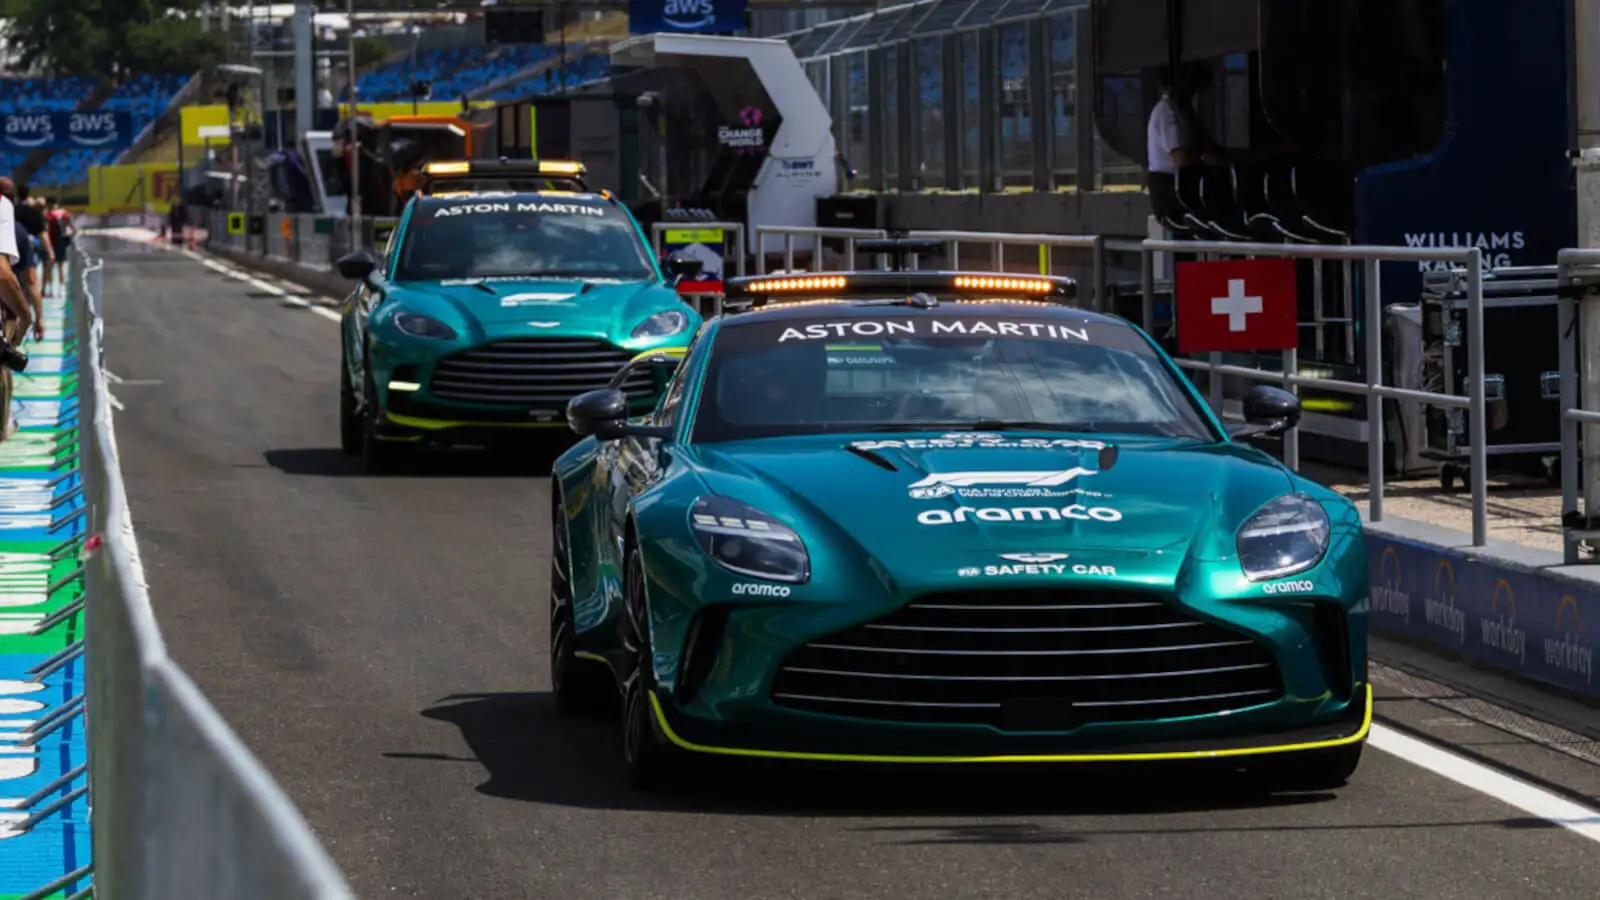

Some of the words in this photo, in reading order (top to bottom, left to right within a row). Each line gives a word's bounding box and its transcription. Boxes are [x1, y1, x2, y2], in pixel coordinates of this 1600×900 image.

[664, 0, 714, 15] aws
[6, 115, 53, 133] aws
[69, 113, 116, 132] aws
[434, 202, 509, 218] ASTON
[517, 202, 604, 217] MARTIN
[1404, 231, 1525, 249] WILLIAMS
[1418, 252, 1512, 273] RACNG
[777, 320, 916, 342] ASTON
[931, 319, 1090, 342] MARTIN
[917, 503, 1123, 525] aramco
[984, 564, 1066, 576] SAFETY
[1072, 564, 1117, 577] CAR
[731, 583, 791, 597] aramco
[1263, 580, 1314, 595] aramco
[1371, 579, 1410, 624] workday
[1424, 592, 1465, 644] workday
[1481, 614, 1526, 665] workday
[1544, 631, 1592, 684] workday
